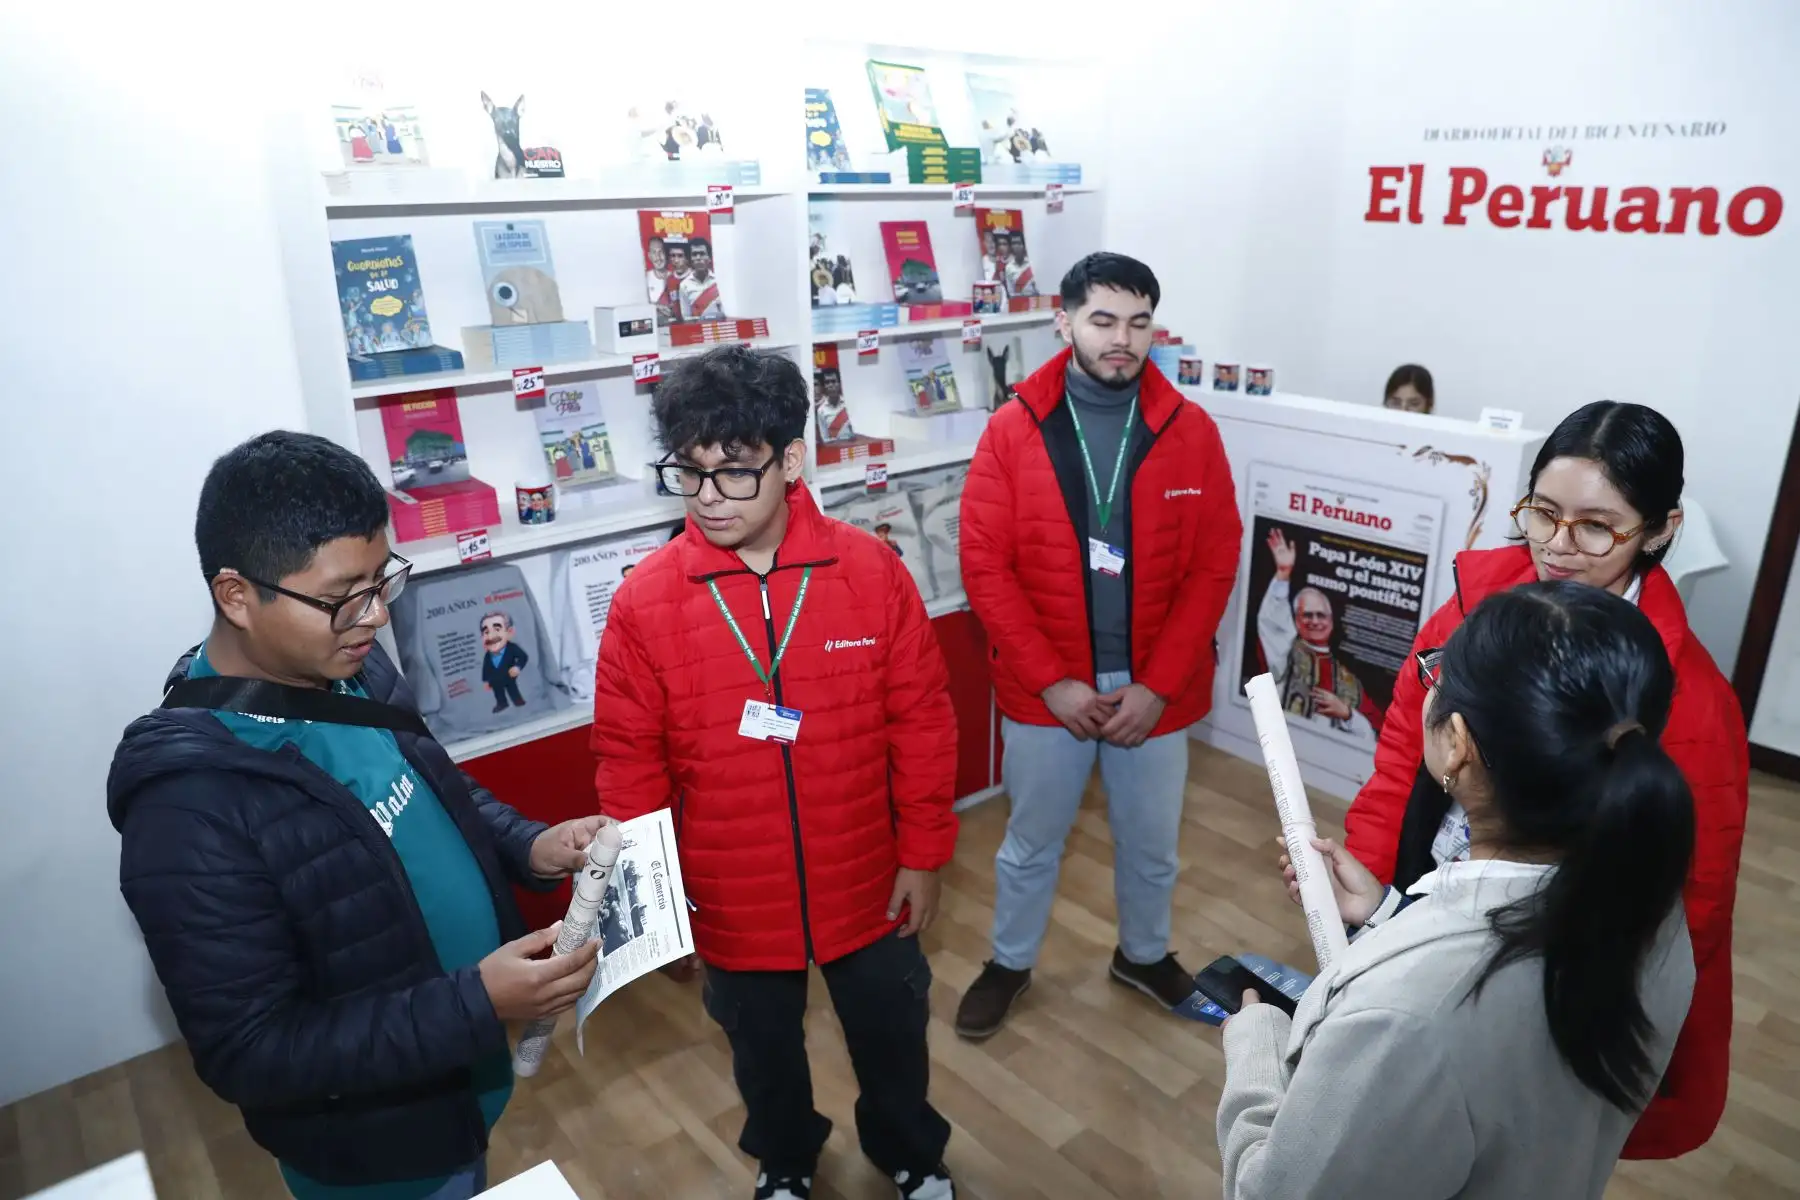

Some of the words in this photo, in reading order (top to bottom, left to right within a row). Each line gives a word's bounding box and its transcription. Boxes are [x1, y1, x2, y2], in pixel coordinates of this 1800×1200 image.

[523, 146, 560, 161] CAN
[1364, 164, 1426, 225] El
[1443, 166, 1784, 237] Peruano
[366, 278, 399, 292] SALUD
[1288, 492, 1307, 513] El
[1311, 501, 1393, 531] Peruano
[573, 555, 591, 568] 200
[591, 549, 619, 563] AÑOS
[1308, 541, 1347, 565] Papa
[1348, 552, 1387, 572] León
[1389, 559, 1424, 582] XIV
[1306, 573, 1347, 594] sumo
[1349, 582, 1419, 612] pontífice
[1335, 566, 1352, 579] es
[1354, 568, 1369, 583] el
[1370, 575, 1421, 597] nuevo
[425, 606, 446, 620] 200
[446, 596, 478, 614] AÑOS
[835, 640, 861, 649] Editora
[862, 637, 877, 647] Perú
[651, 860, 662, 871] El
[652, 872, 668, 910] Comercio
